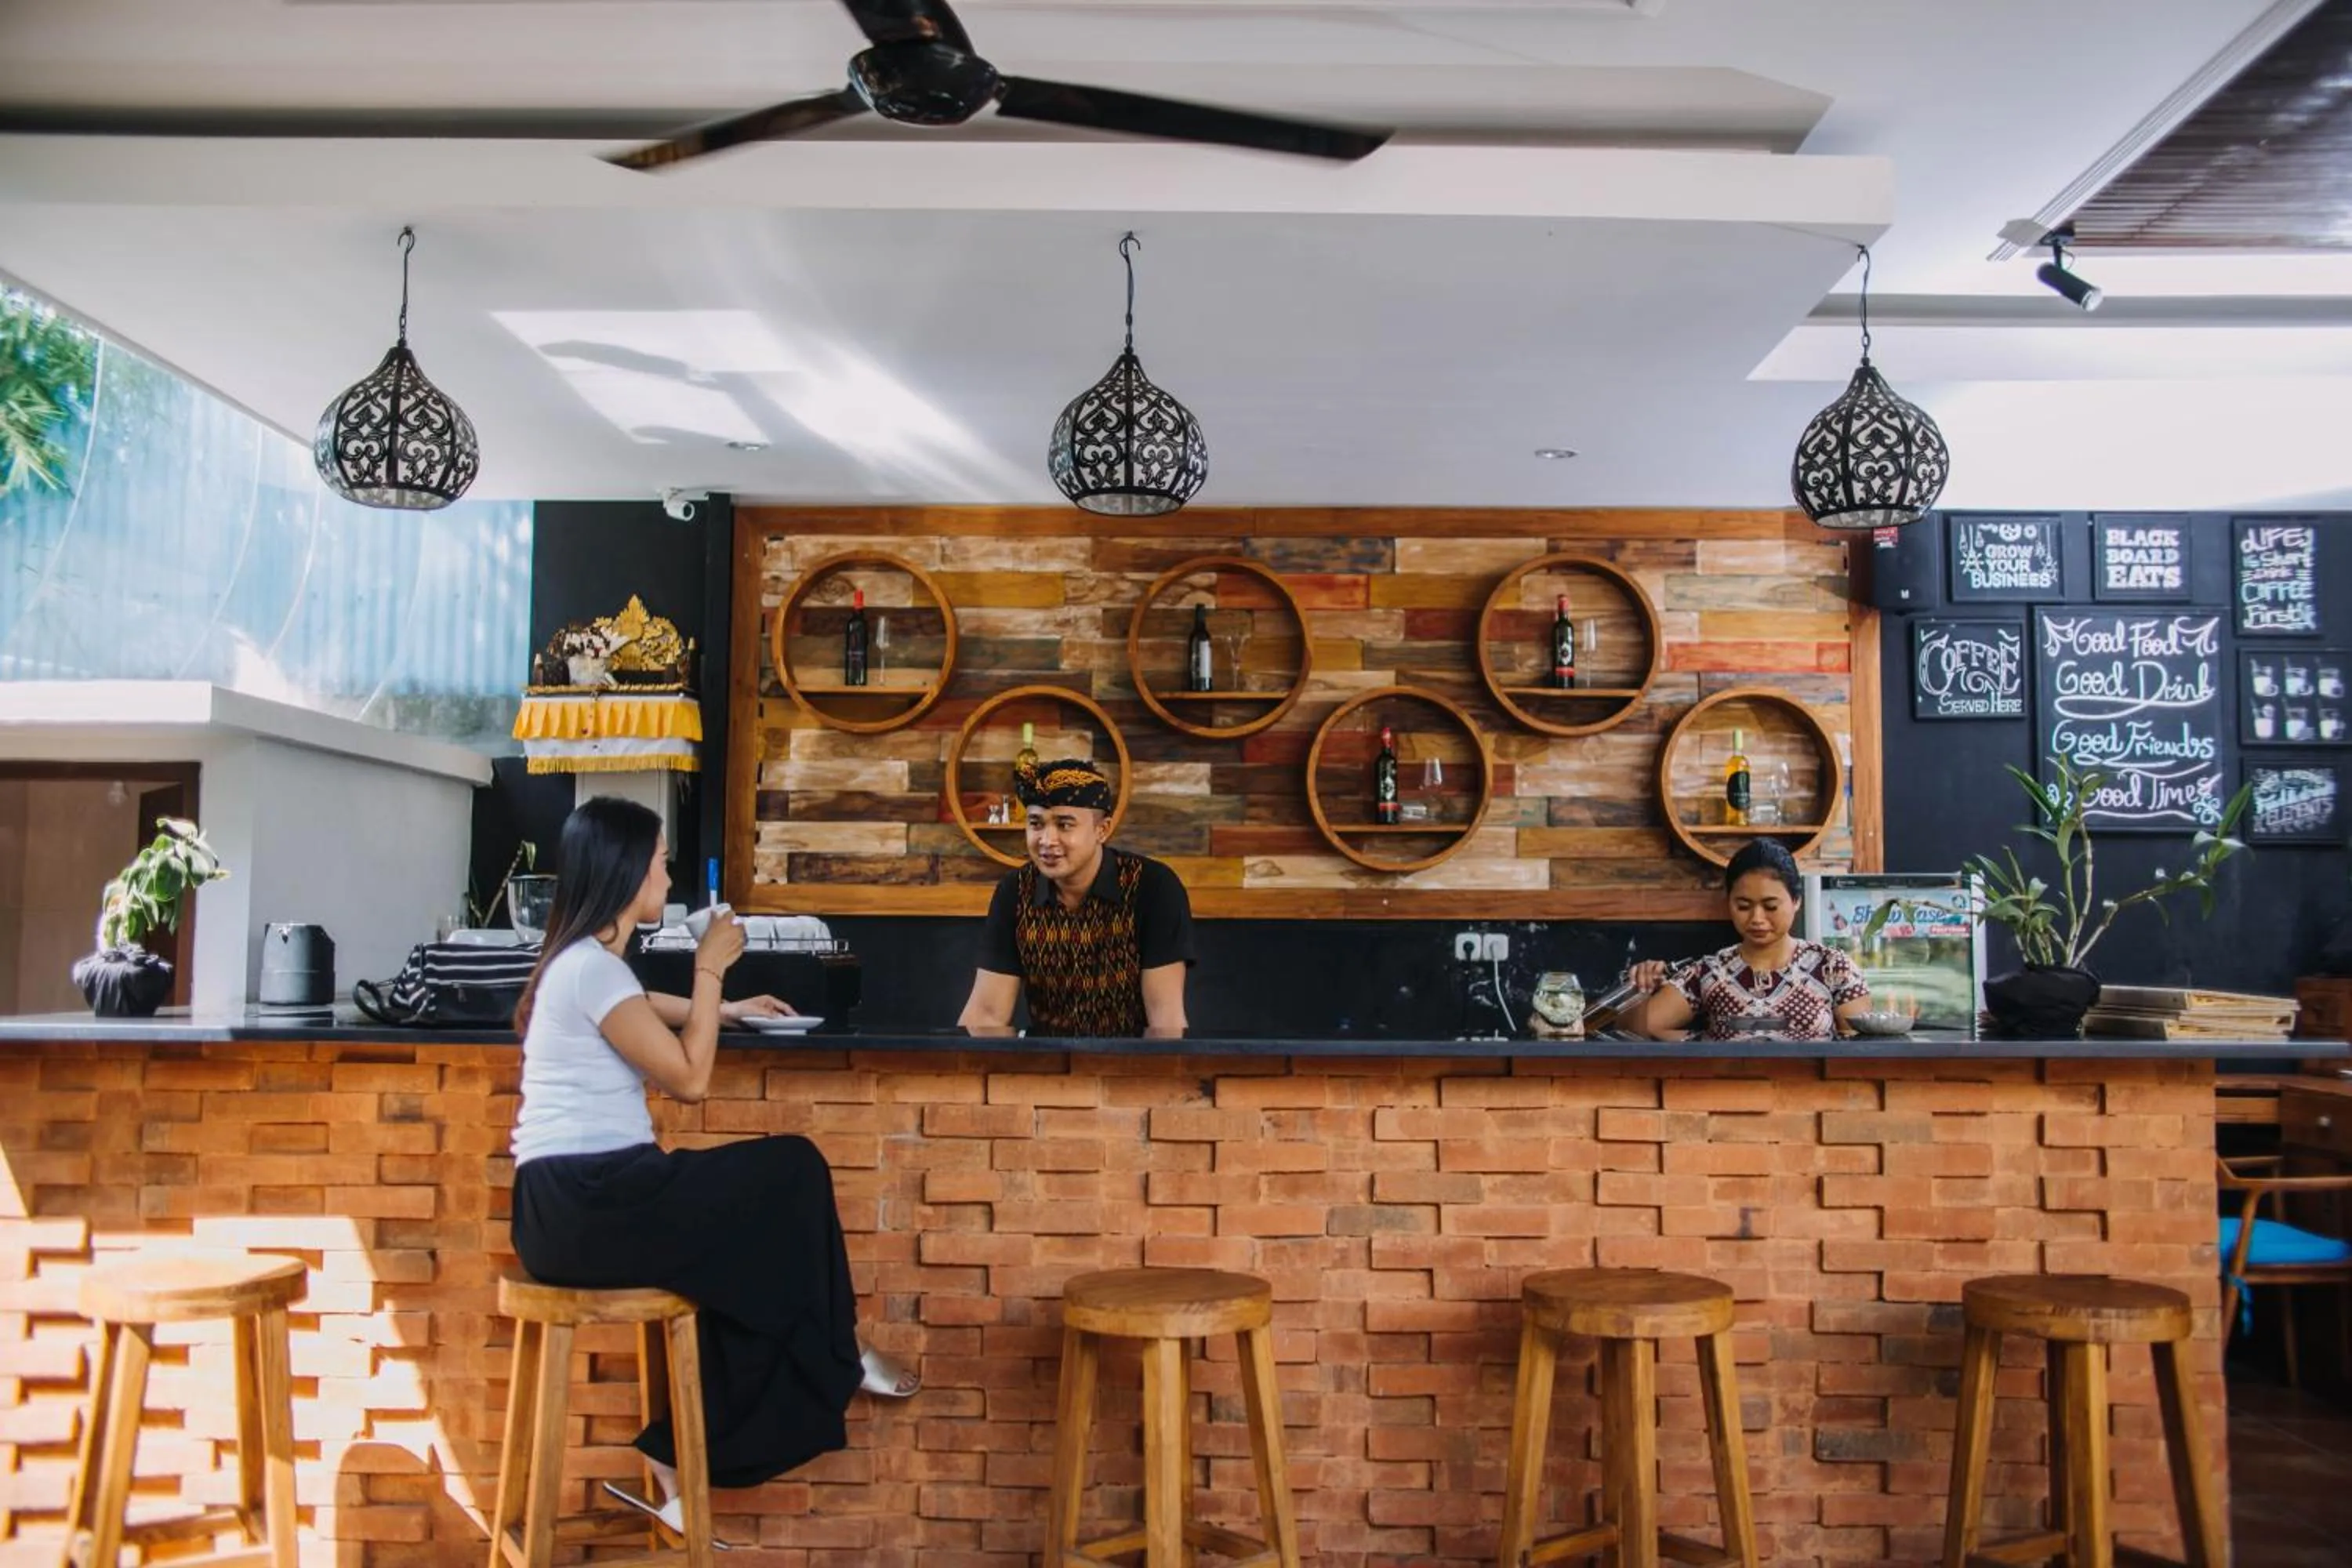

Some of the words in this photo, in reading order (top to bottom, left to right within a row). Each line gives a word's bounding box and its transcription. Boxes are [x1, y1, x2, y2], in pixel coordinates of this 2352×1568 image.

[2106, 529, 2180, 547] BLACK
[1985, 544, 2034, 559] GROW
[2106, 548, 2180, 564] BOARD
[1985, 559, 2031, 572] YOUR
[2107, 564, 2182, 588] EATS
[2073, 619, 2128, 655] Good
[2129, 619, 2183, 658] Food
[2056, 660, 2129, 696] Good
[2051, 719, 2124, 753] Good
[2119, 720, 2216, 763] Friends
